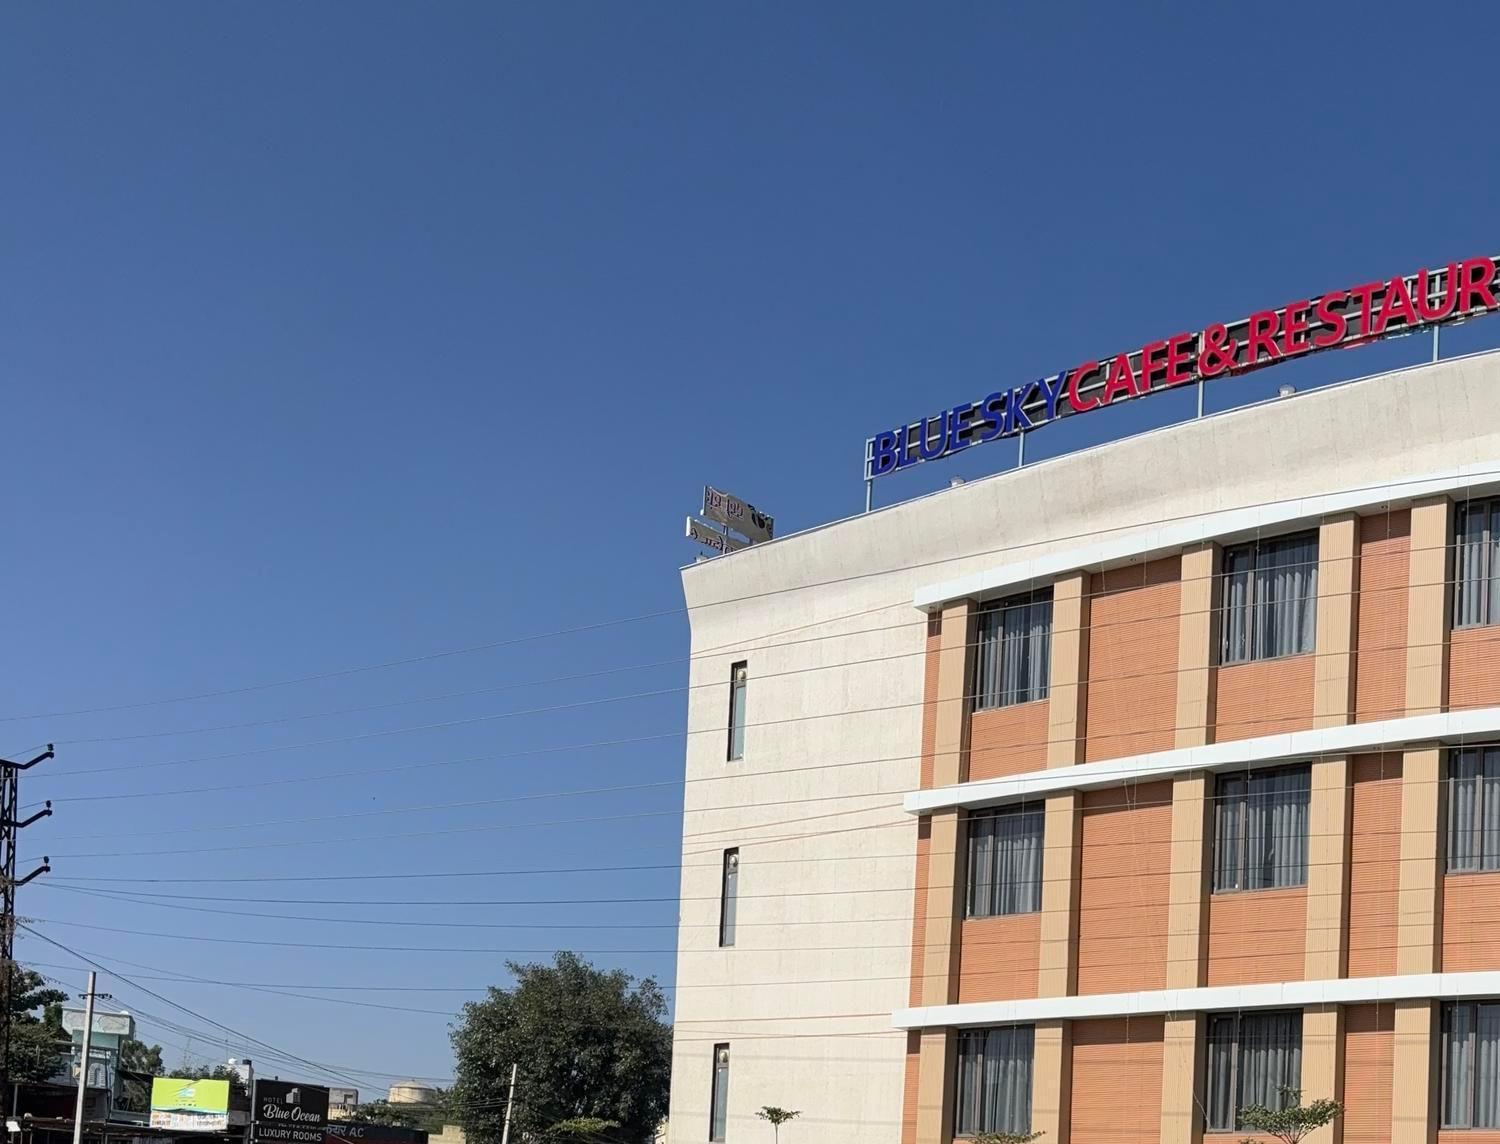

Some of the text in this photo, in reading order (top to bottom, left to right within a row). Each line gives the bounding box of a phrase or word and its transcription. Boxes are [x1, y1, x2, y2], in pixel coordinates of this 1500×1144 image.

[870, 403, 973, 477] BLUE
[977, 369, 1068, 442] SKY
[263, 1103, 321, 1122] Blue Ocean
[258, 1127, 323, 1142] LUXURY ROOMS
[349, 1126, 365, 1138] AC
